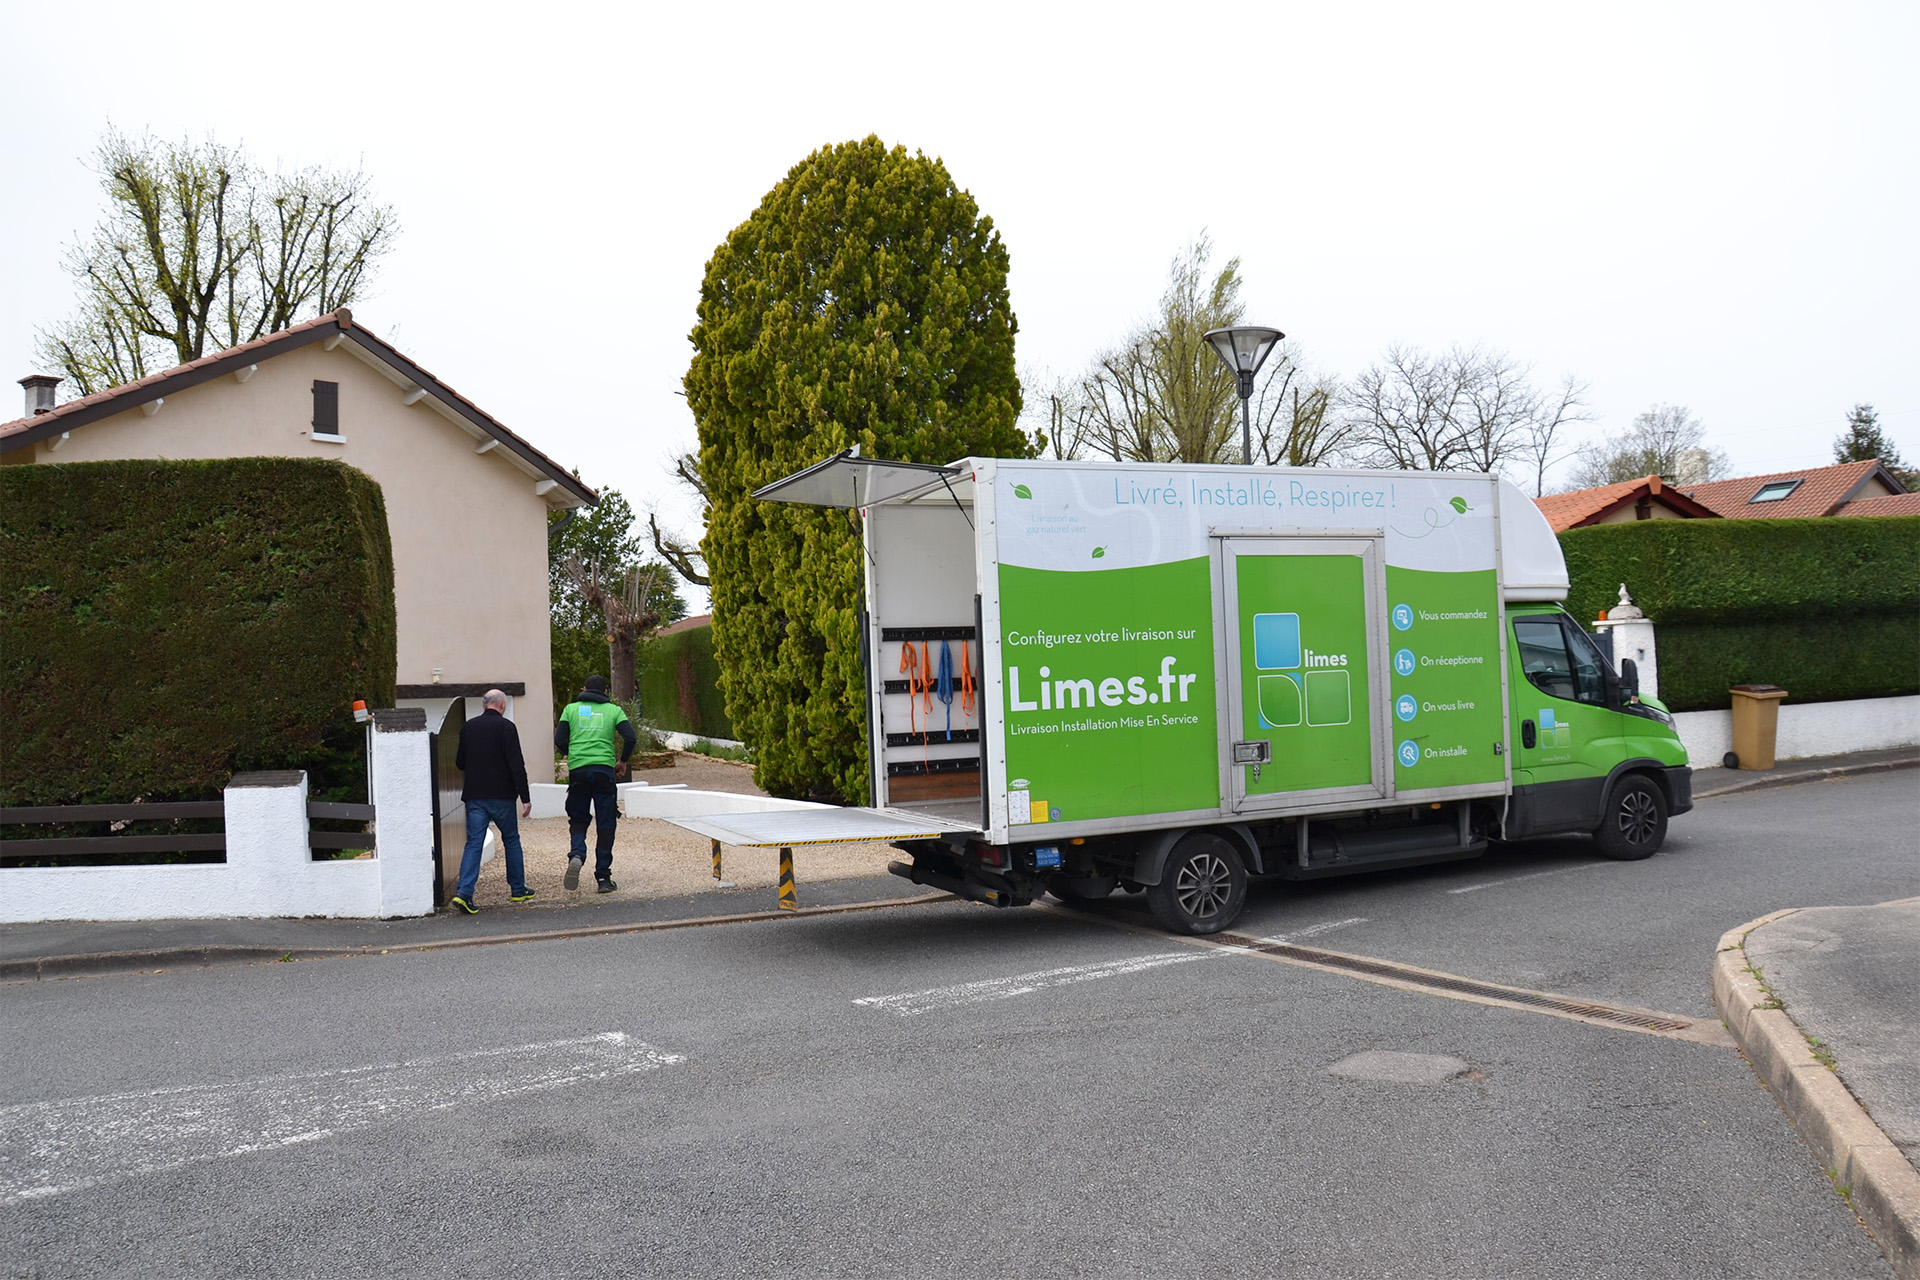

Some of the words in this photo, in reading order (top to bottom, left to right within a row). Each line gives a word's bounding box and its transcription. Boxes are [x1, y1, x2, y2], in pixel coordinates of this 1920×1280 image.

[1114, 478, 1183, 508] Livré,
[1192, 478, 1282, 509] Installé,
[1290, 481, 1384, 514] Respirez
[1392, 484, 1396, 508] !
[1031, 514, 1067, 523] Livraison
[1026, 527, 1040, 536] gaz
[1419, 611, 1439, 621] Vous
[1440, 610, 1487, 619] commandez
[1008, 630, 1082, 648] Configurez
[1085, 630, 1119, 643] votre
[1122, 627, 1174, 642] livraison
[1177, 629, 1196, 639] sur
[1304, 649, 1347, 667] limes
[1421, 656, 1435, 666] On
[1435, 655, 1483, 667] réceptionne
[1009, 655, 1197, 712] Limes.fr
[1423, 701, 1436, 712] On
[1437, 703, 1456, 711] vous
[1457, 700, 1475, 710] livre
[1011, 722, 1059, 735] Livraison
[1061, 719, 1118, 732] Installation
[1120, 717, 1144, 728] Mise
[1147, 715, 1160, 726] En
[1161, 714, 1198, 725] Service
[1424, 748, 1438, 758] On
[1439, 745, 1467, 757] installe
